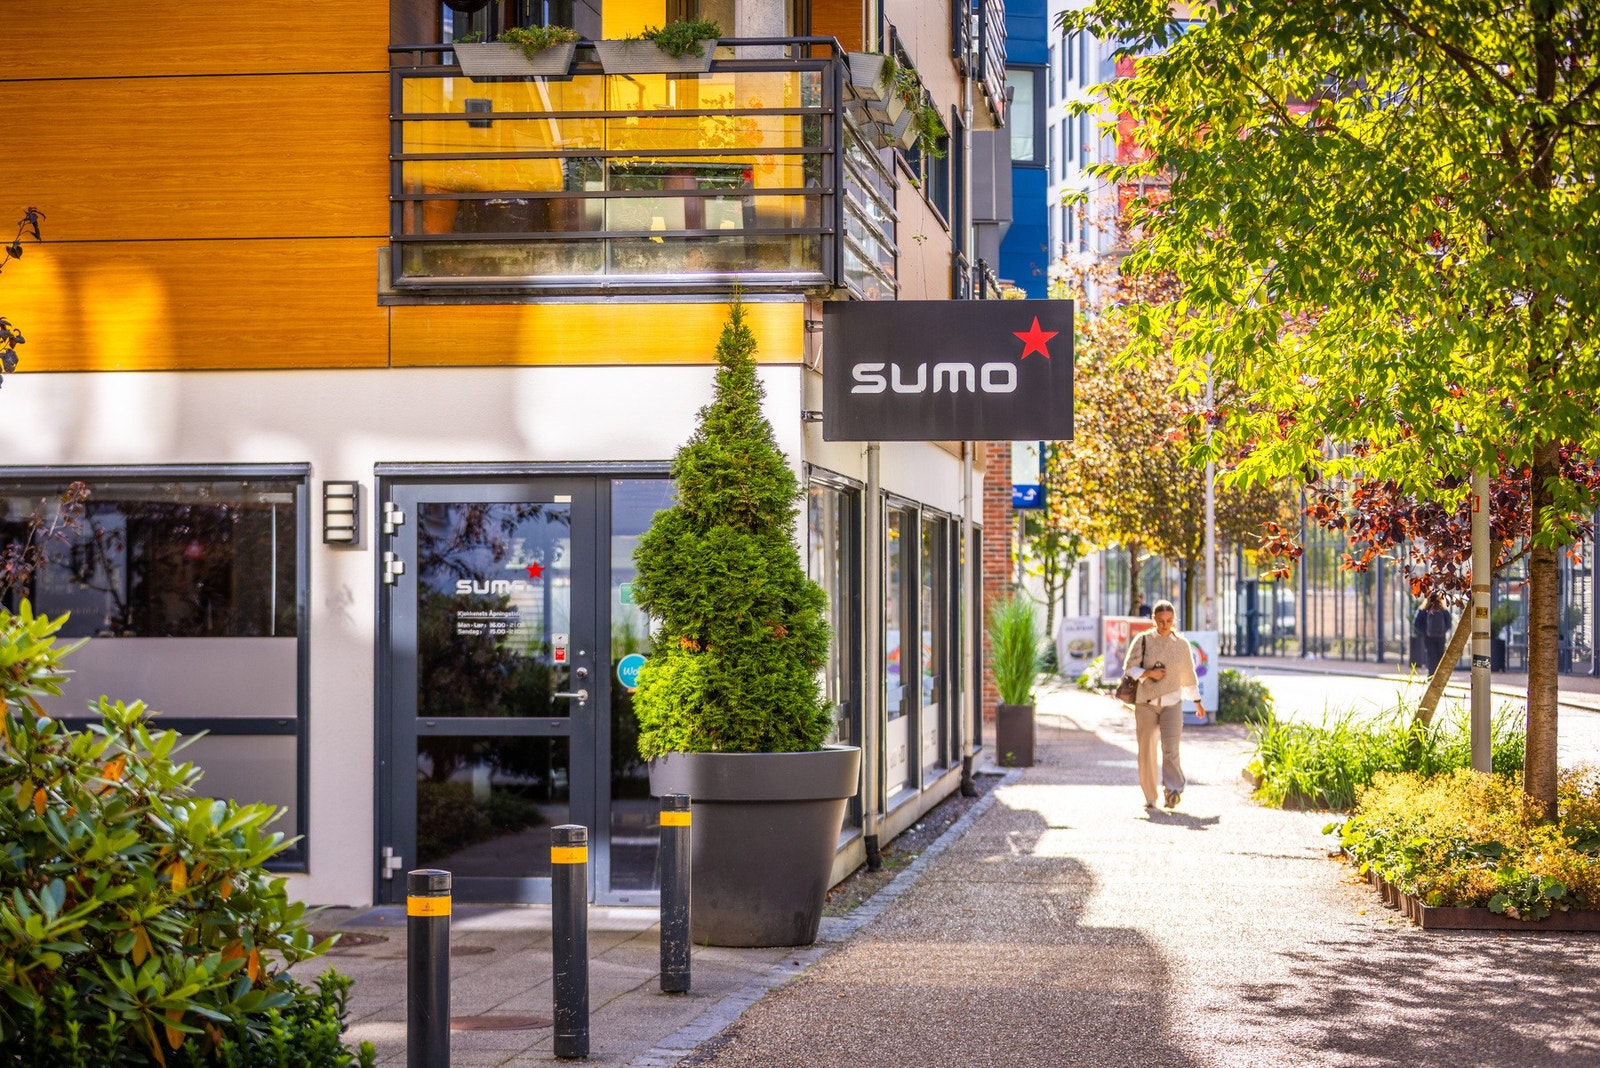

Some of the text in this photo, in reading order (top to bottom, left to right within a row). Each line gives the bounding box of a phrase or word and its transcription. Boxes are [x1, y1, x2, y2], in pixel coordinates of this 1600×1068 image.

[851, 362, 1018, 394] SUMO
[488, 609, 525, 618] Åpningstid
[623, 666, 639, 676] Wo
